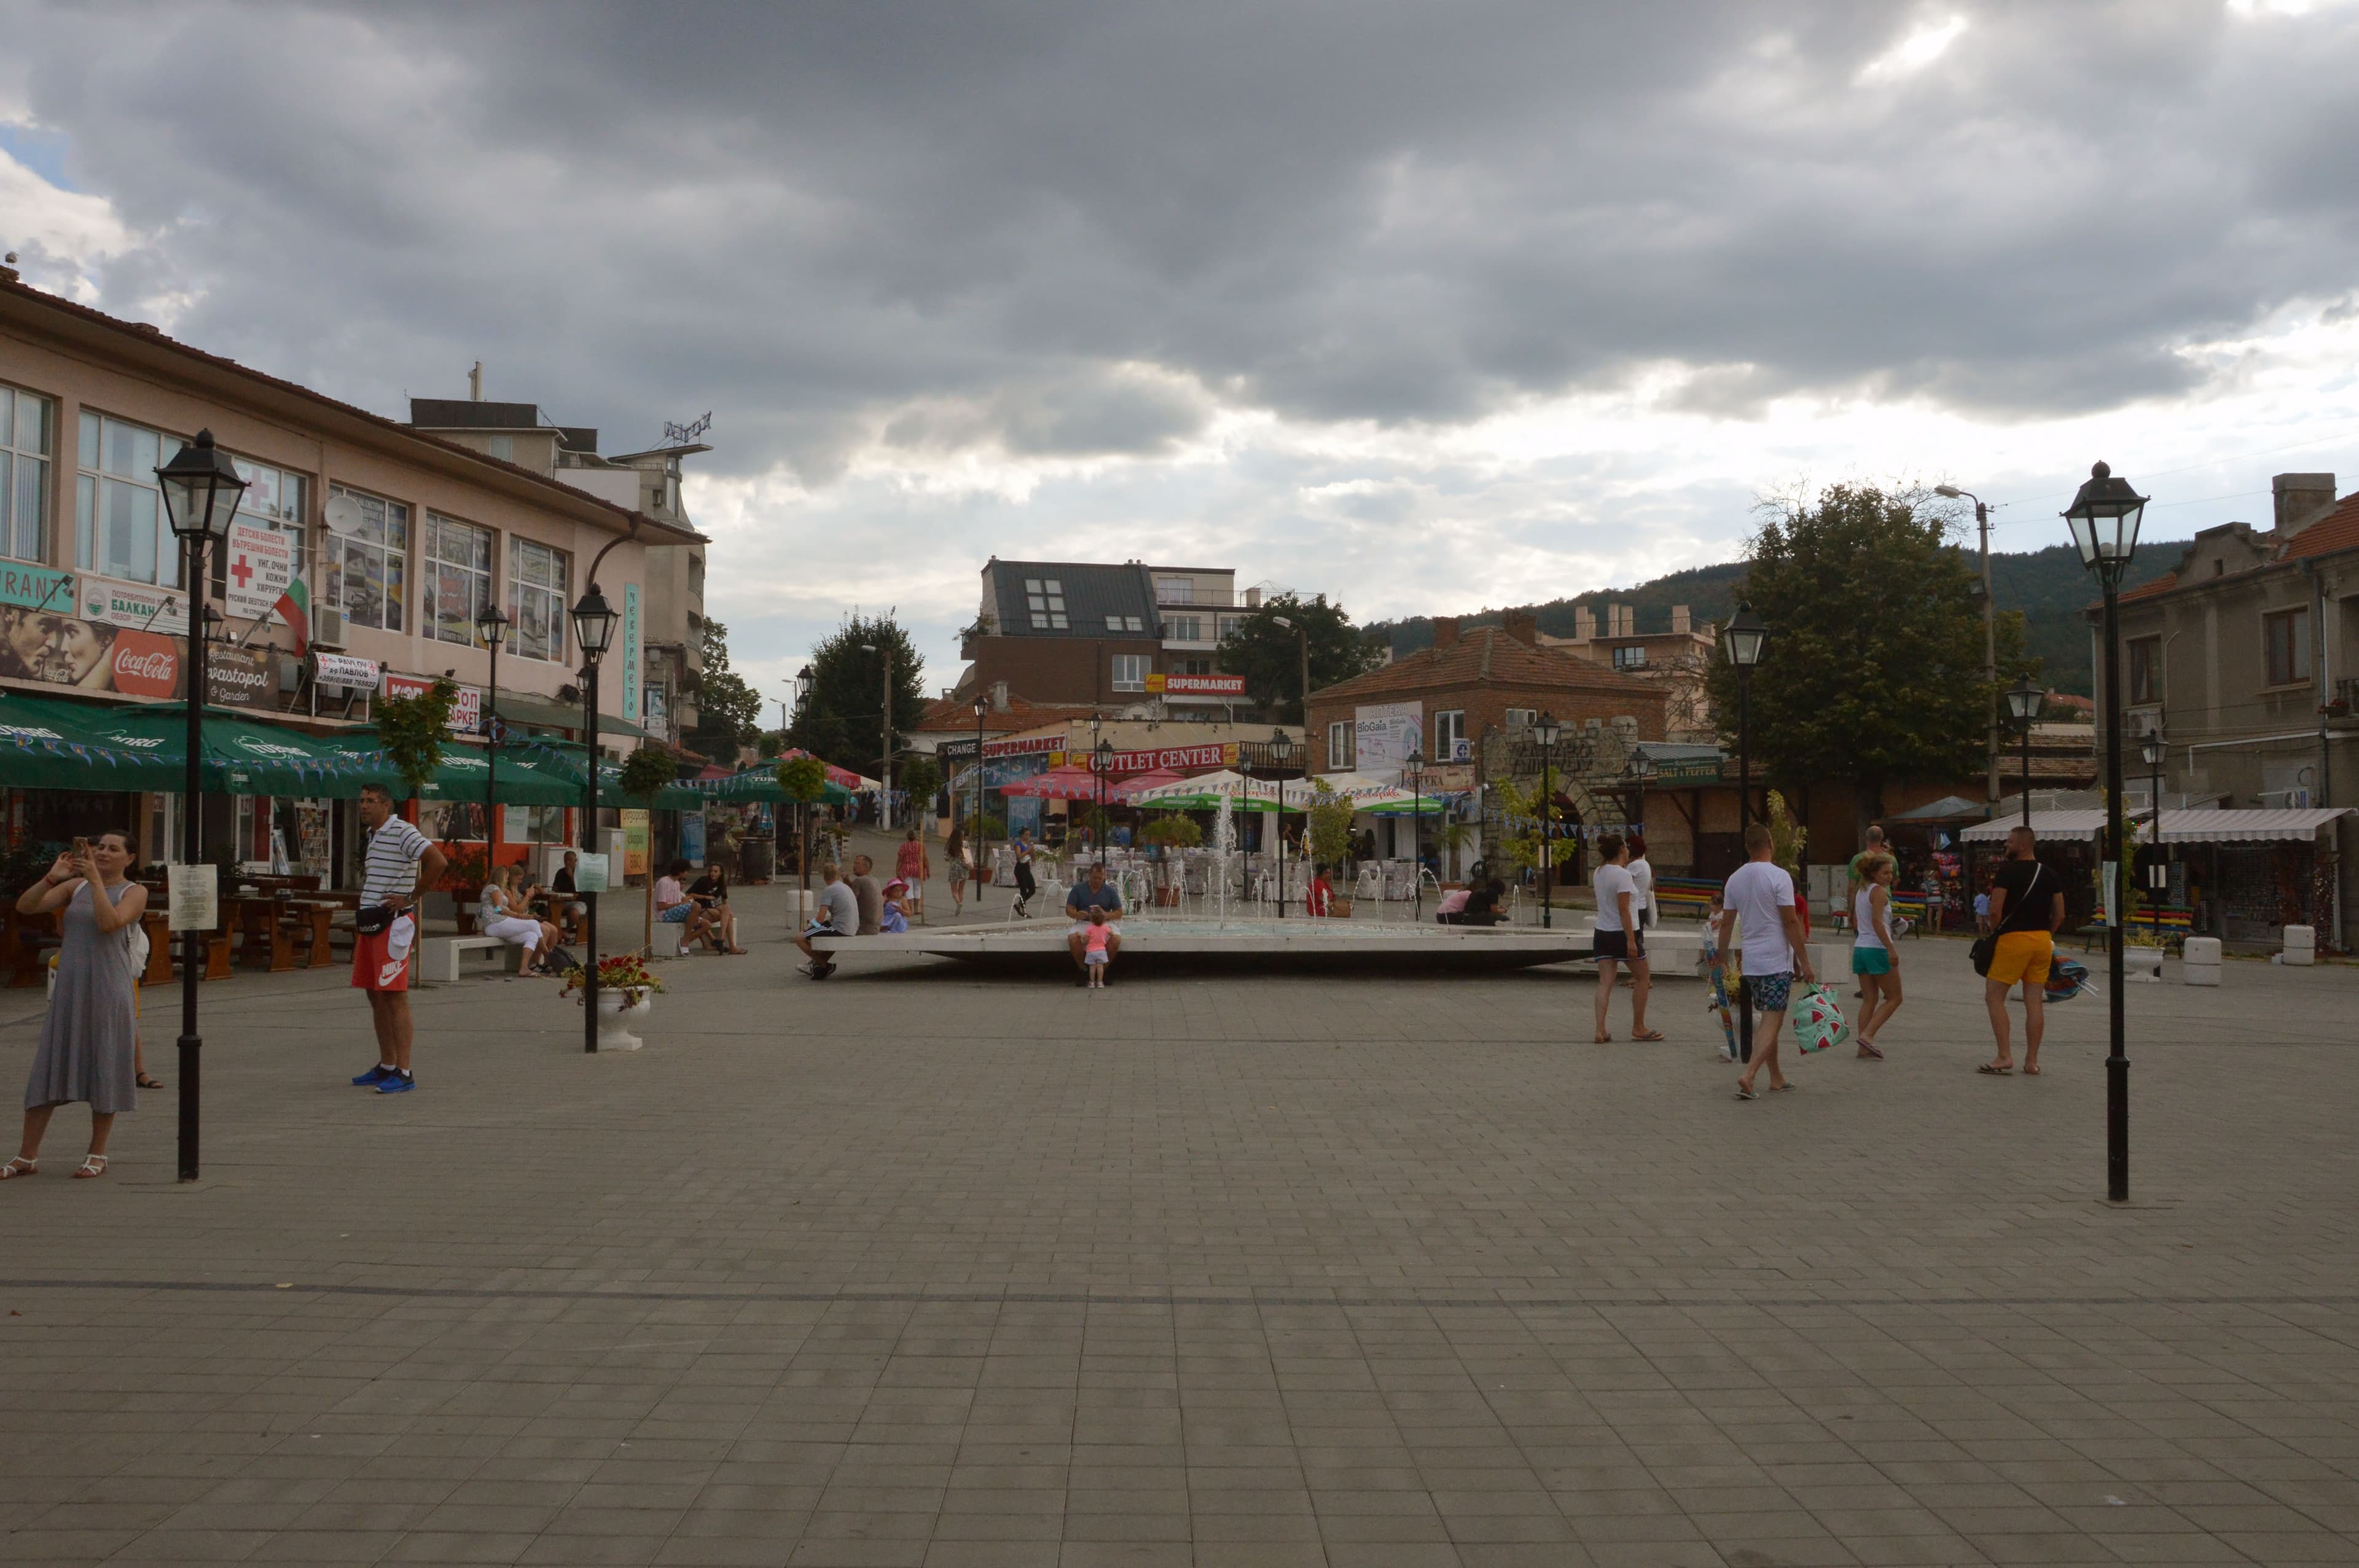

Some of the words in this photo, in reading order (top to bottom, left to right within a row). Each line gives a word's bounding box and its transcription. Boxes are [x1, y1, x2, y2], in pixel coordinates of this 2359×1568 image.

[238, 526, 260, 540] ДЕТСКИ
[260, 532, 285, 545] БОЛЕСТИ
[232, 539, 264, 554] ВЪТРЕШНИ
[264, 545, 289, 559] БОЛЕСТИ
[272, 561, 288, 572] ОЧНИ
[266, 572, 288, 584] КОЖНИ
[112, 589, 155, 604] ПОТРЕБИТЕЛНА
[248, 596, 269, 607] DEUTSCH
[111, 599, 155, 617] БАЛКАН
[111, 612, 131, 621] ОБЗОР
[208, 648, 254, 666] Restaurant
[338, 658, 367, 668] PAVLOV
[115, 648, 174, 681] Coca-Cola
[339, 667, 369, 677] ПАВЛОВ
[1167, 678, 1242, 690] SUPERMARKET
[219, 688, 251, 701] Garden
[1369, 703, 1409, 719] АПТЕКА
[448, 710, 478, 727] АРКЕТ
[1357, 720, 1387, 733] BioGaia
[947, 743, 977, 755] CHANGE
[982, 736, 1065, 757] SUPERMARKET
[1159, 746, 1222, 767] CENTER
[1658, 768, 1678, 778] SALT
[382, 961, 402, 977] NIKE
